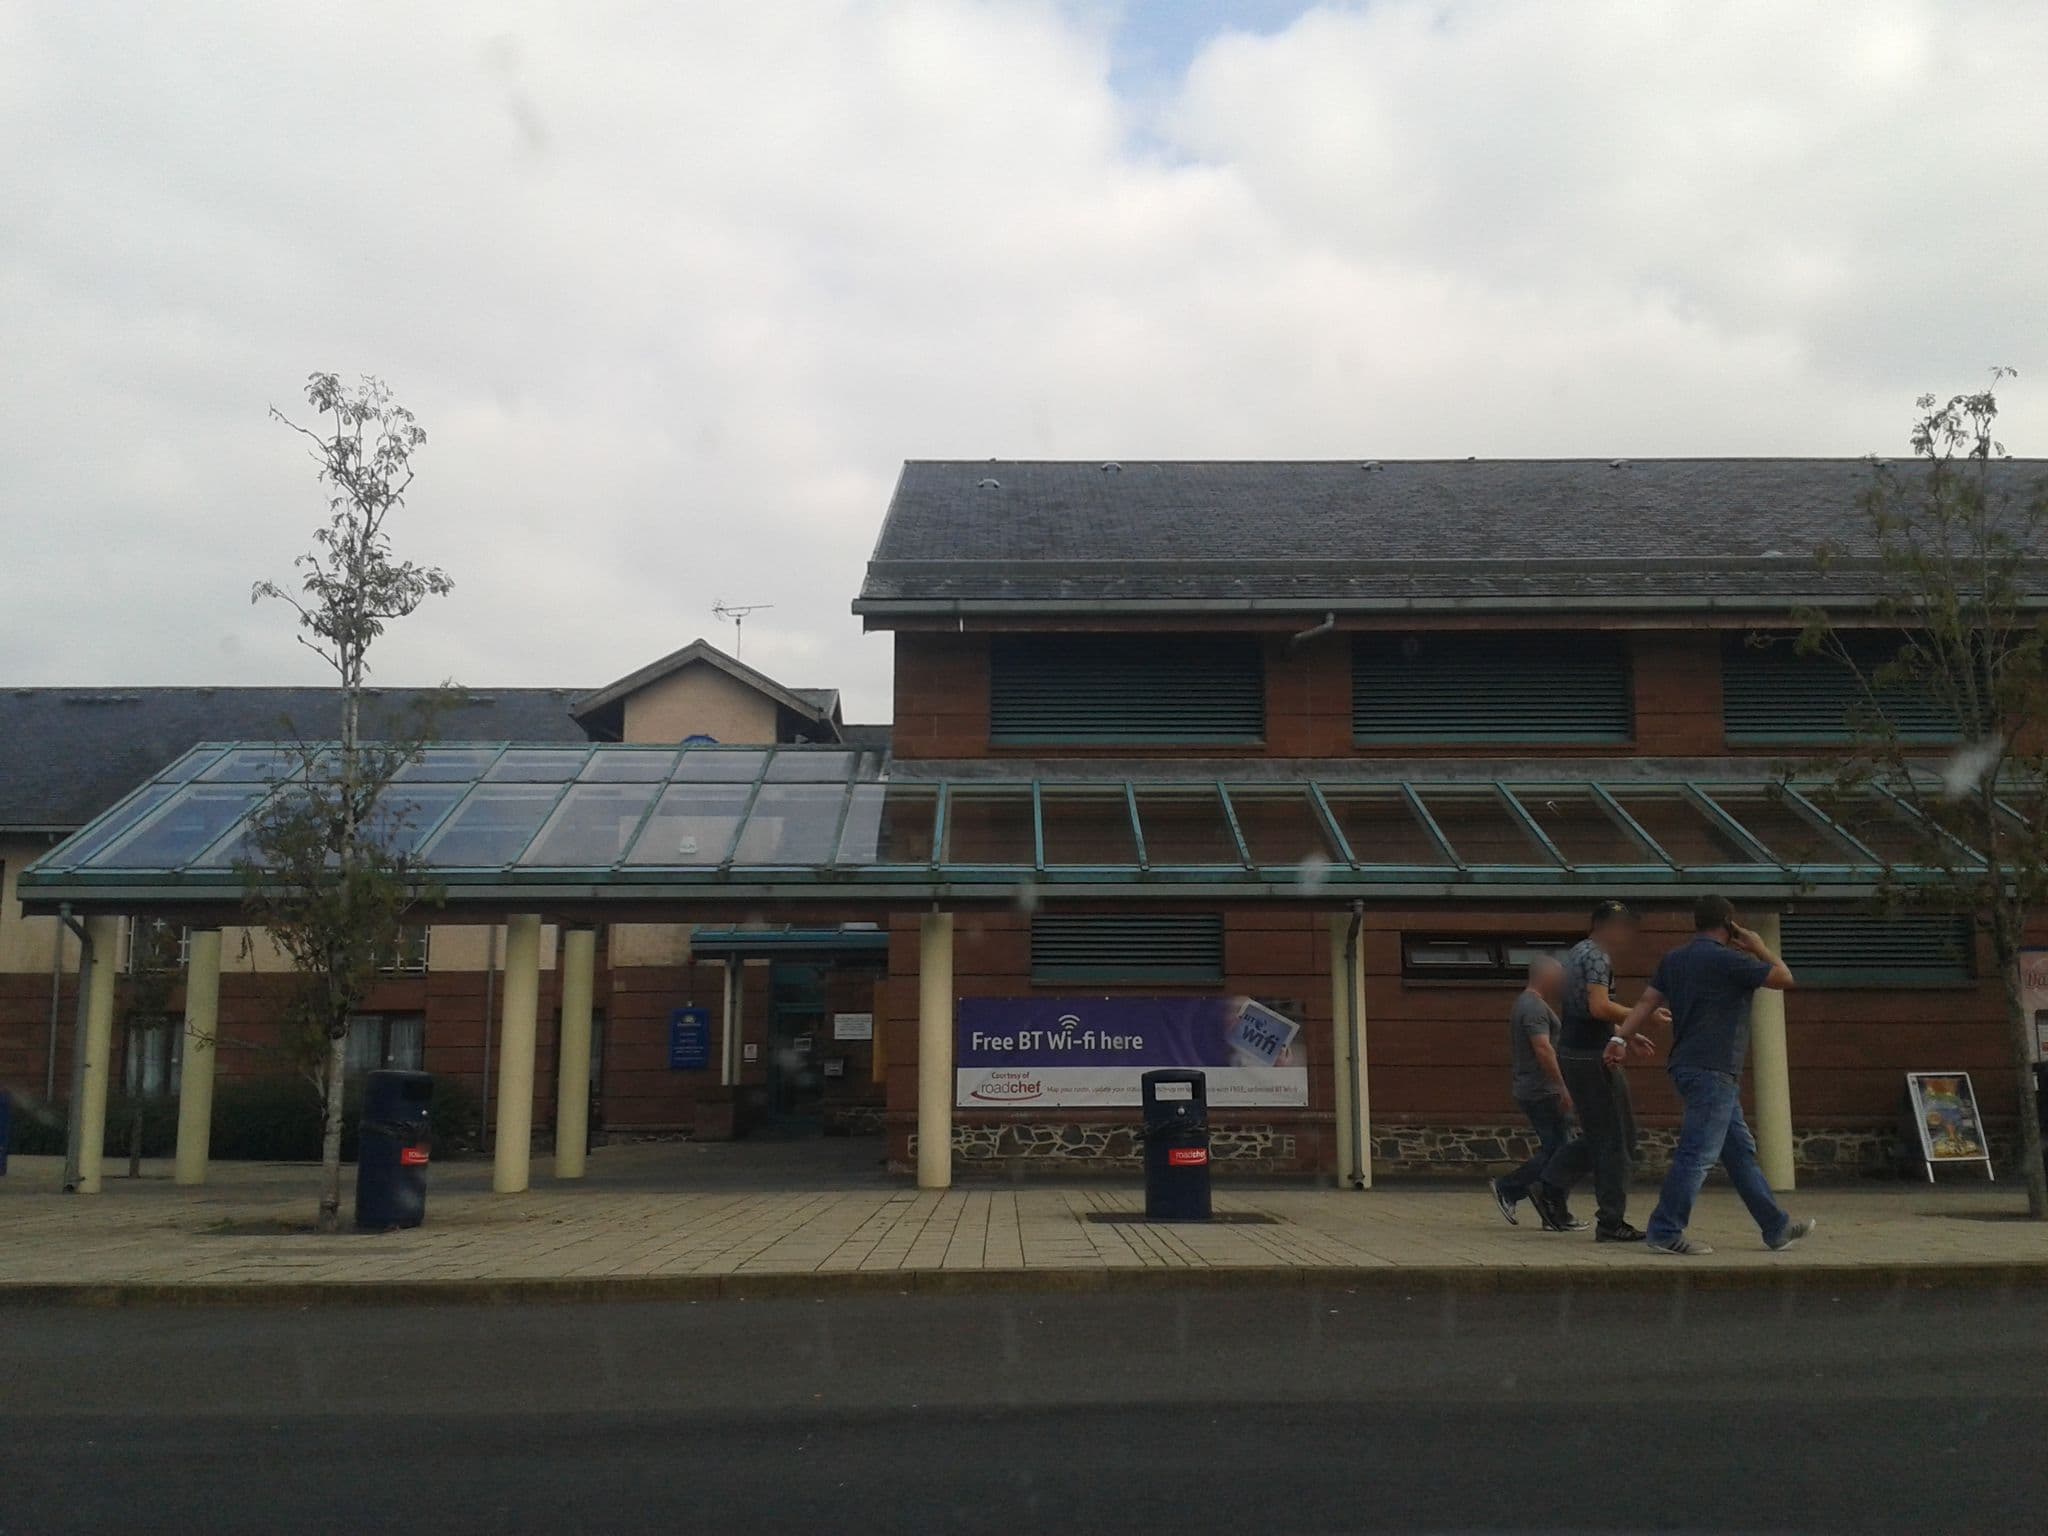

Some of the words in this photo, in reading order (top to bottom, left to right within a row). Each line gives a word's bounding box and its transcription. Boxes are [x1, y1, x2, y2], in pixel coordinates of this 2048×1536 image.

[972, 1031, 1014, 1051] Free
[1018, 1031, 1043, 1051] BT
[1047, 1030, 1095, 1051] Wi-fi
[1100, 1030, 1143, 1051] here
[1242, 1025, 1279, 1055] wifi
[991, 1071, 1020, 1080] Courtesy
[1022, 1071, 1030, 1079] of
[981, 1080, 1041, 1094] roadchef
[1175, 1150, 1206, 1159] roadchef
